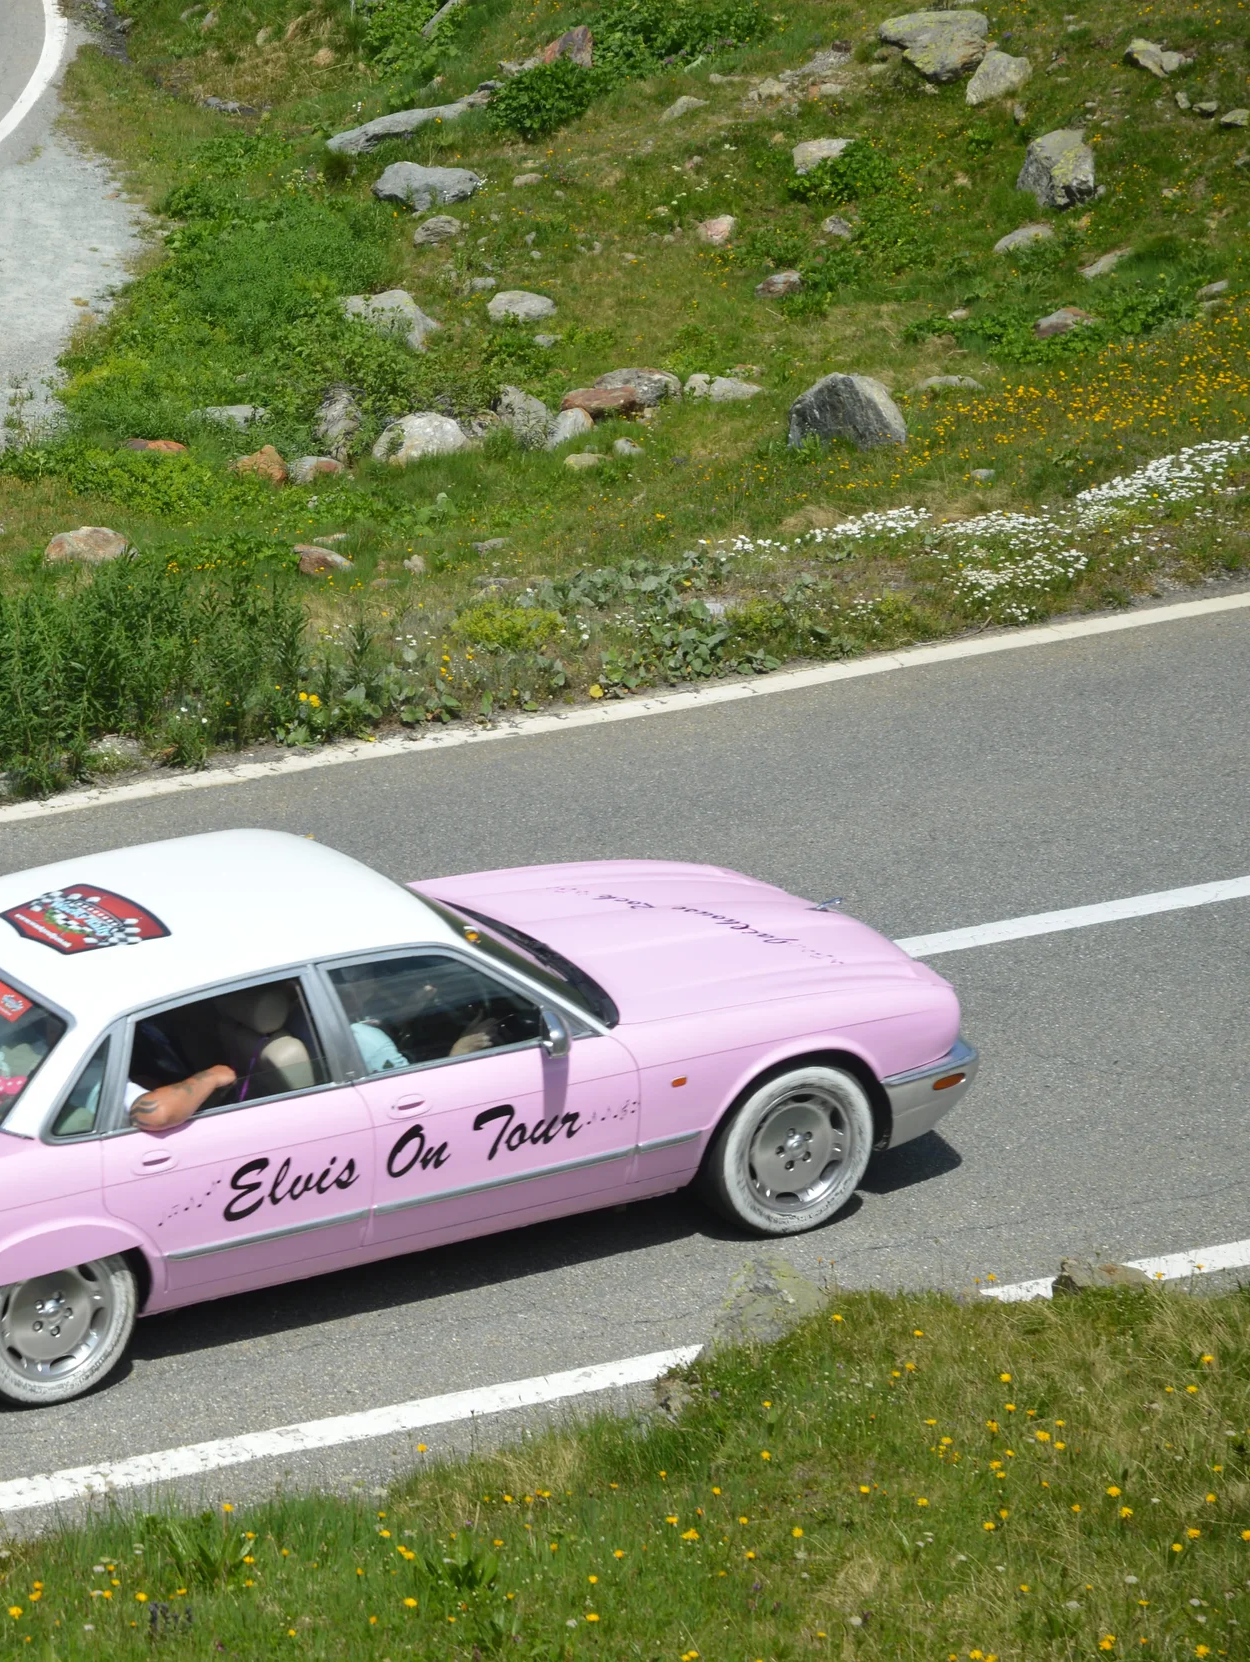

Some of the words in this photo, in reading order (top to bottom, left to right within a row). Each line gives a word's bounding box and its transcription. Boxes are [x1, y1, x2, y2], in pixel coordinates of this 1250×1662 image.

[222, 1156, 361, 1223] Elvis
[386, 1123, 451, 1179] On
[472, 1103, 583, 1162] Tour
